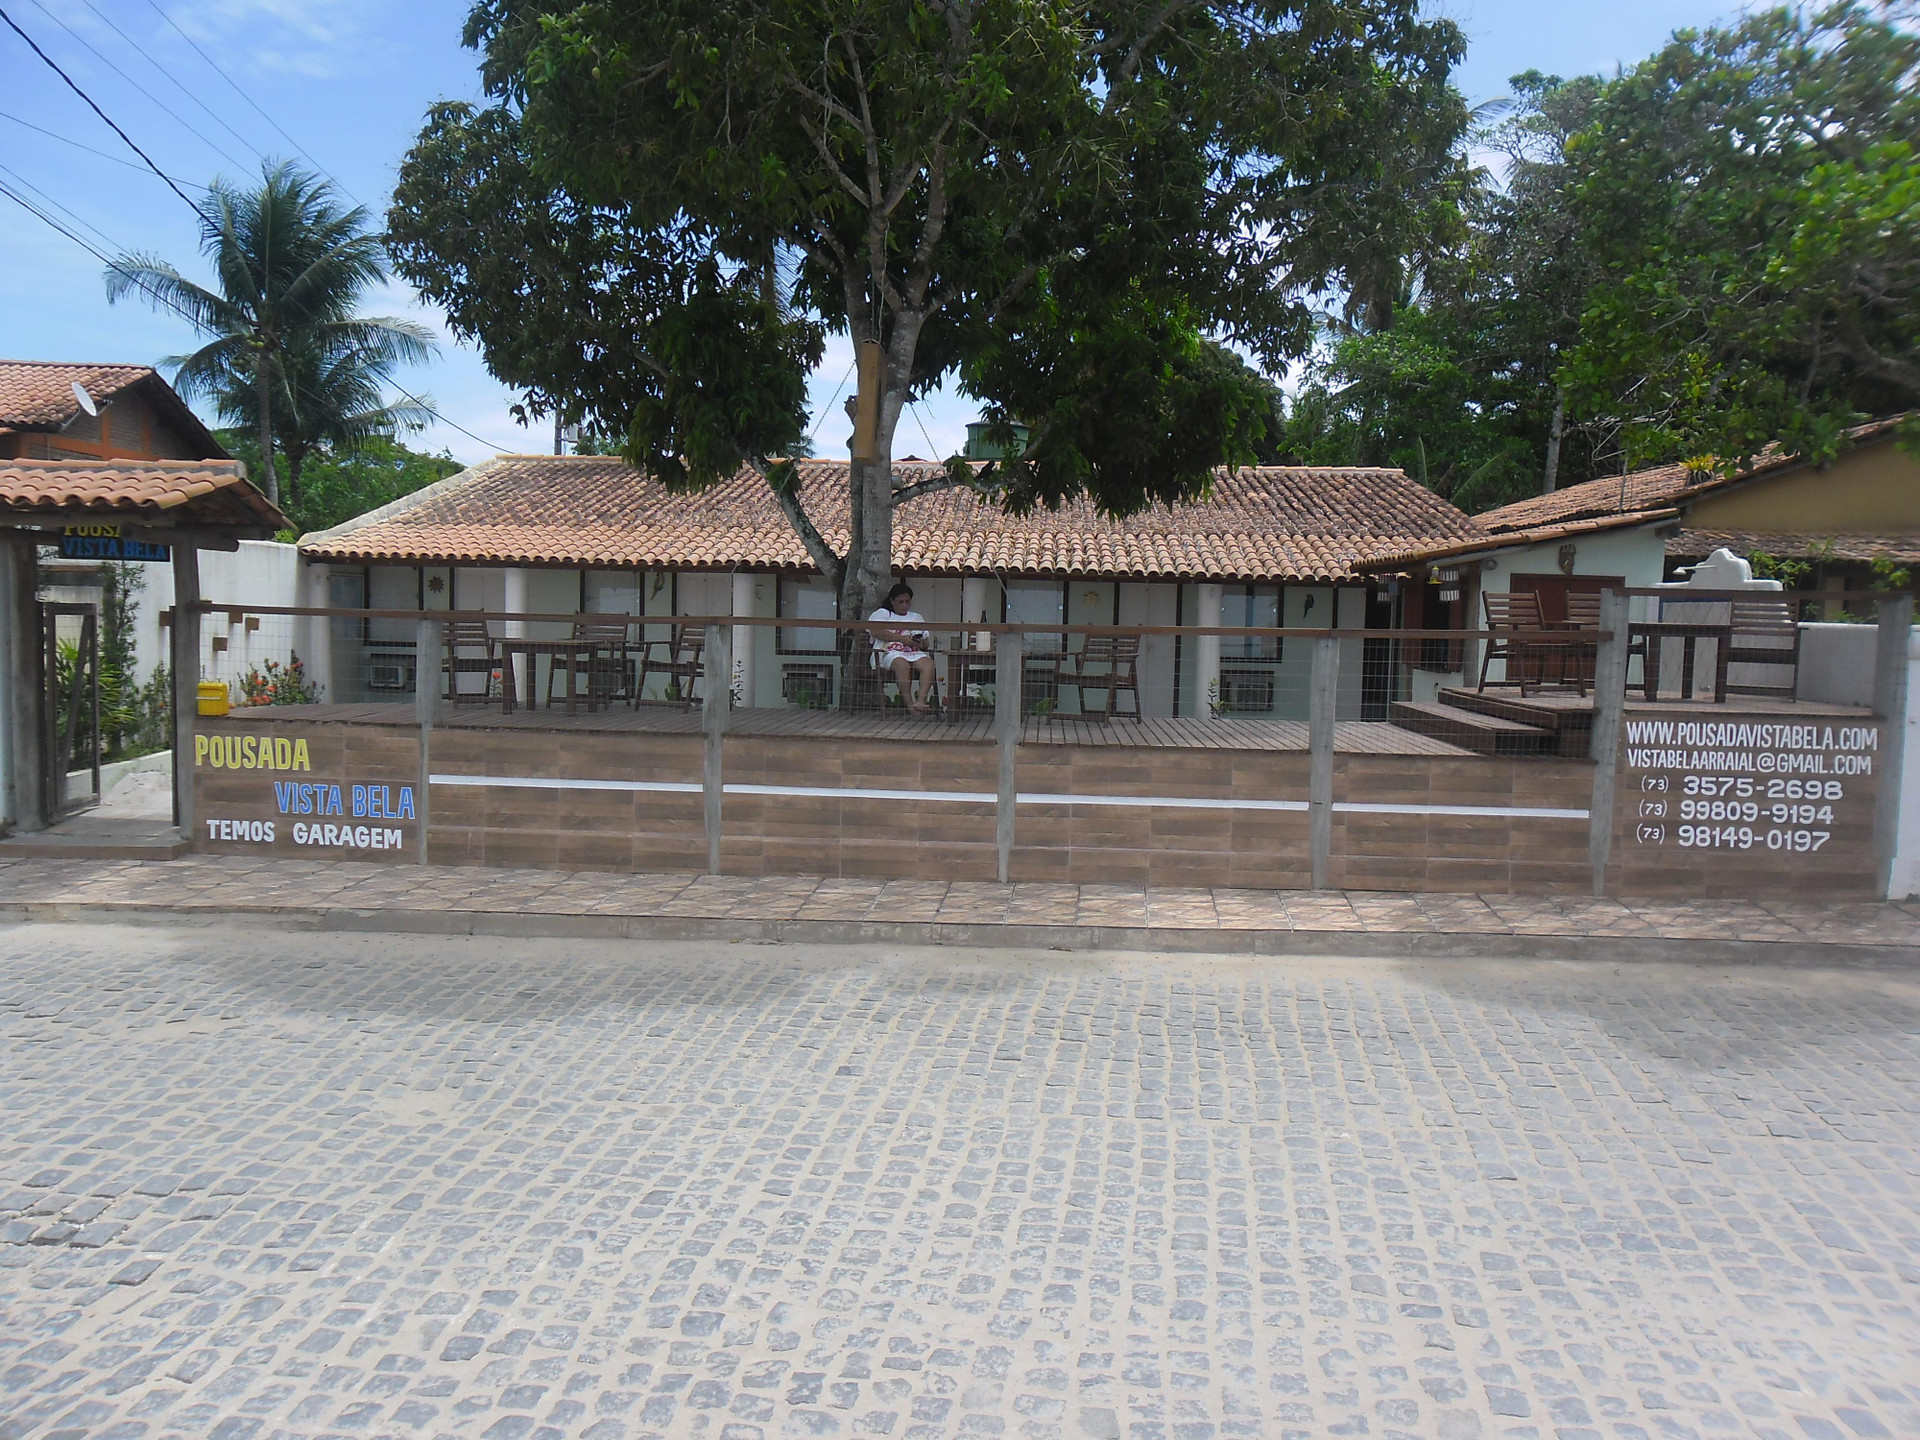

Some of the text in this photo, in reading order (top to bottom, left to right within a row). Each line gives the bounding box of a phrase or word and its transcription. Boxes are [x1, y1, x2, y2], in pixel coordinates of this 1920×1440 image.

[62, 537, 167, 558] VISTA BELA
[1626, 721, 1878, 751] WWW.POUSADAVISTABELA.COM
[195, 734, 311, 771] POUSADA
[1627, 748, 1872, 775] VISTABELAARRAIAL@GMAIL.COM
[274, 781, 416, 820] VISTA BELA
[1641, 774, 1843, 800] (73) 3575-2698
[1639, 798, 1834, 825] (73) 99809-9194
[206, 819, 402, 849] TEMOS GARAGEM
[1636, 823, 1831, 851] (73) 98149-0197
